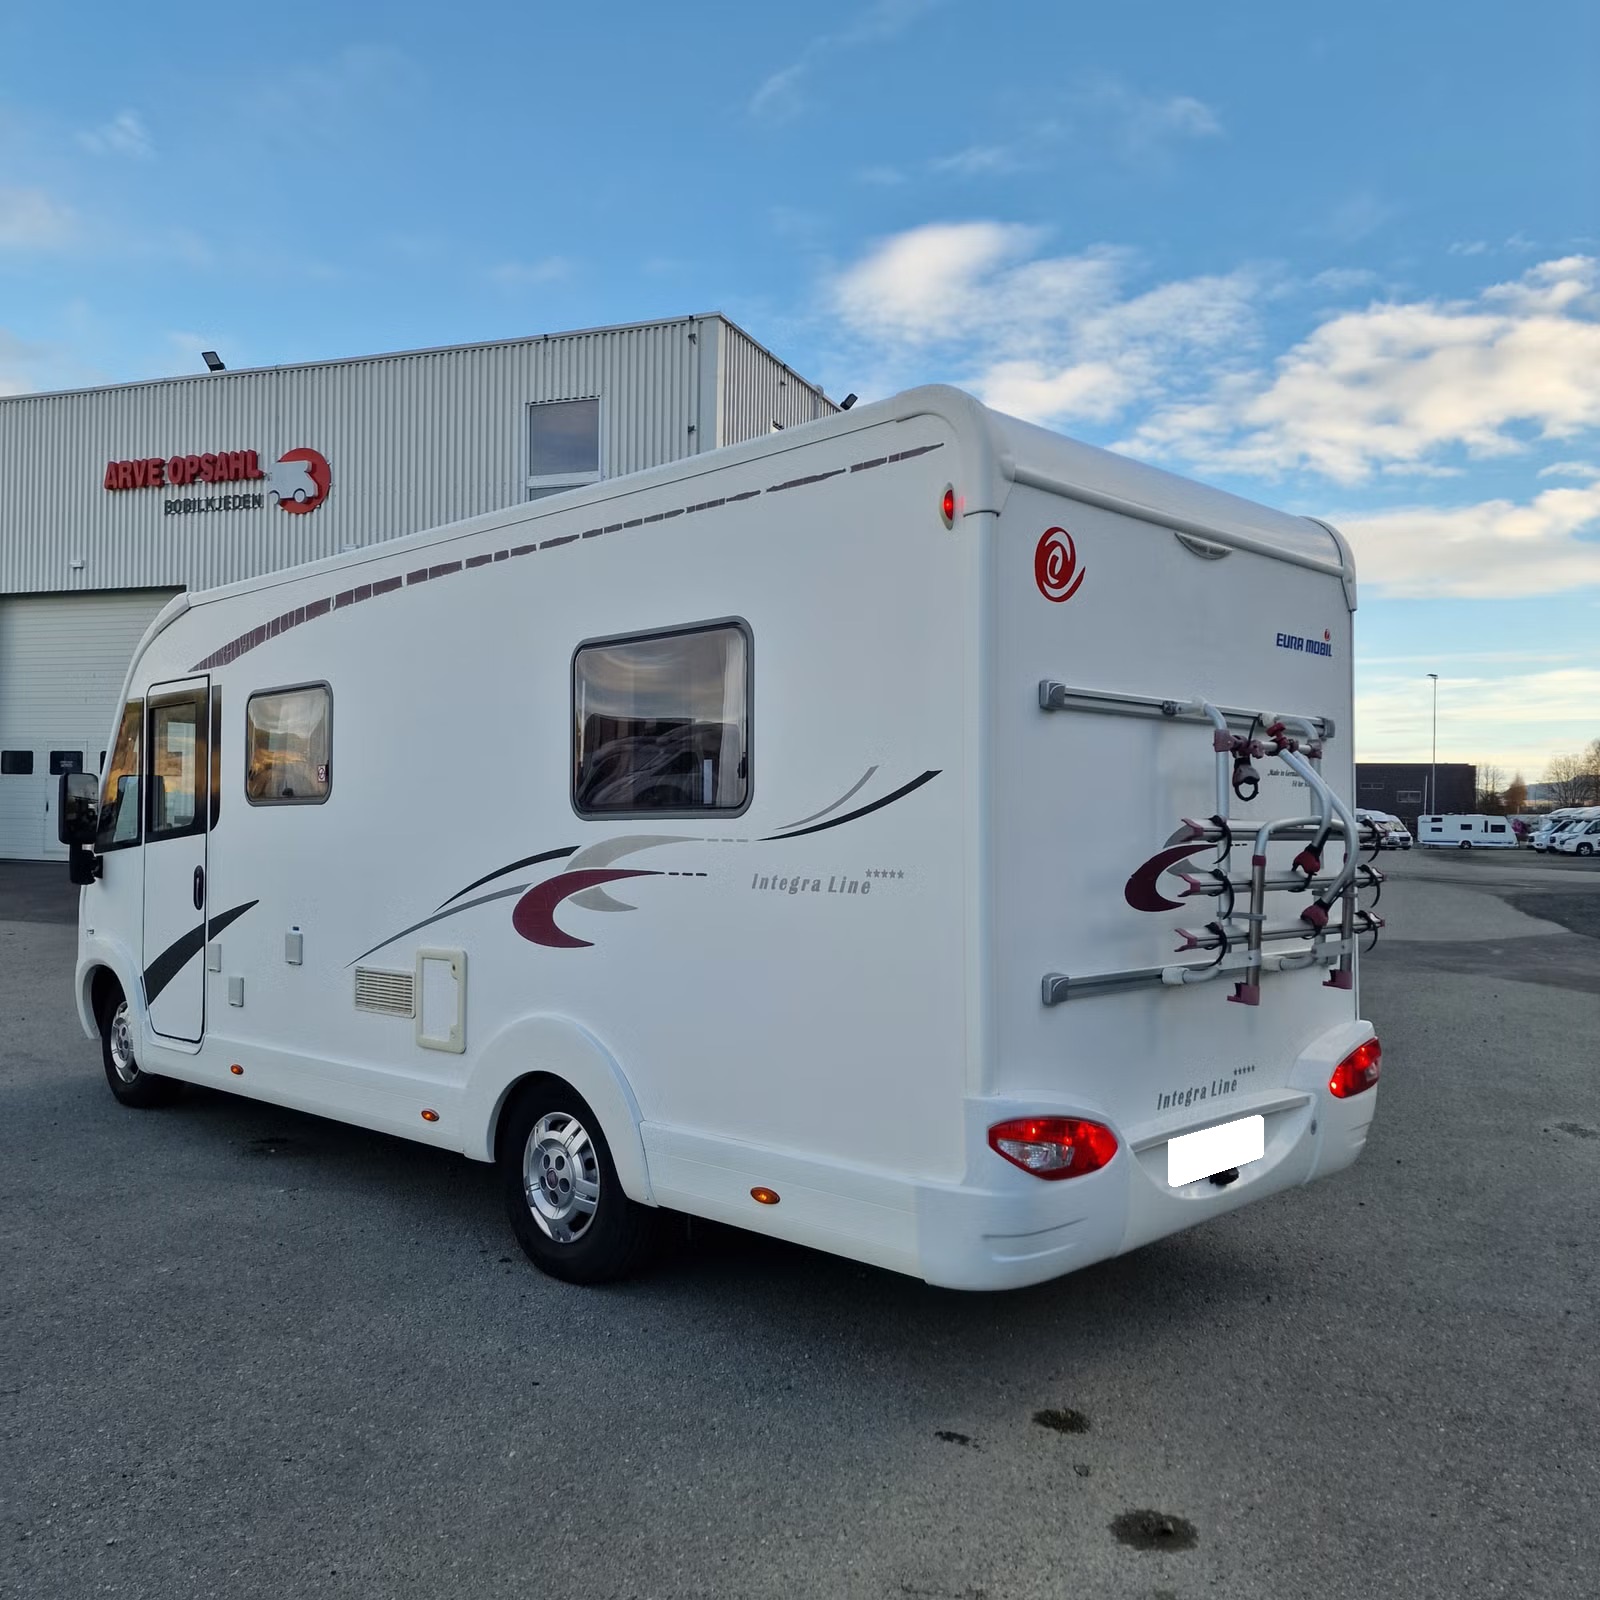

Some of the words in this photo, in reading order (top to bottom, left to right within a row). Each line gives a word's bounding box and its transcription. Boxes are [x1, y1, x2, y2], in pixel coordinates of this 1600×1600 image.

[104, 458, 165, 491] ARVE
[168, 449, 264, 485] OPSAHL
[164, 493, 263, 515] BOBILKJEDEN
[1276, 632, 1304, 651] EURA
[1305, 639, 1332, 657] MOBIL
[751, 873, 821, 895] Integra
[828, 876, 871, 894] Line
[1157, 1086, 1207, 1110] Integra
[1211, 1078, 1237, 1097] Line
